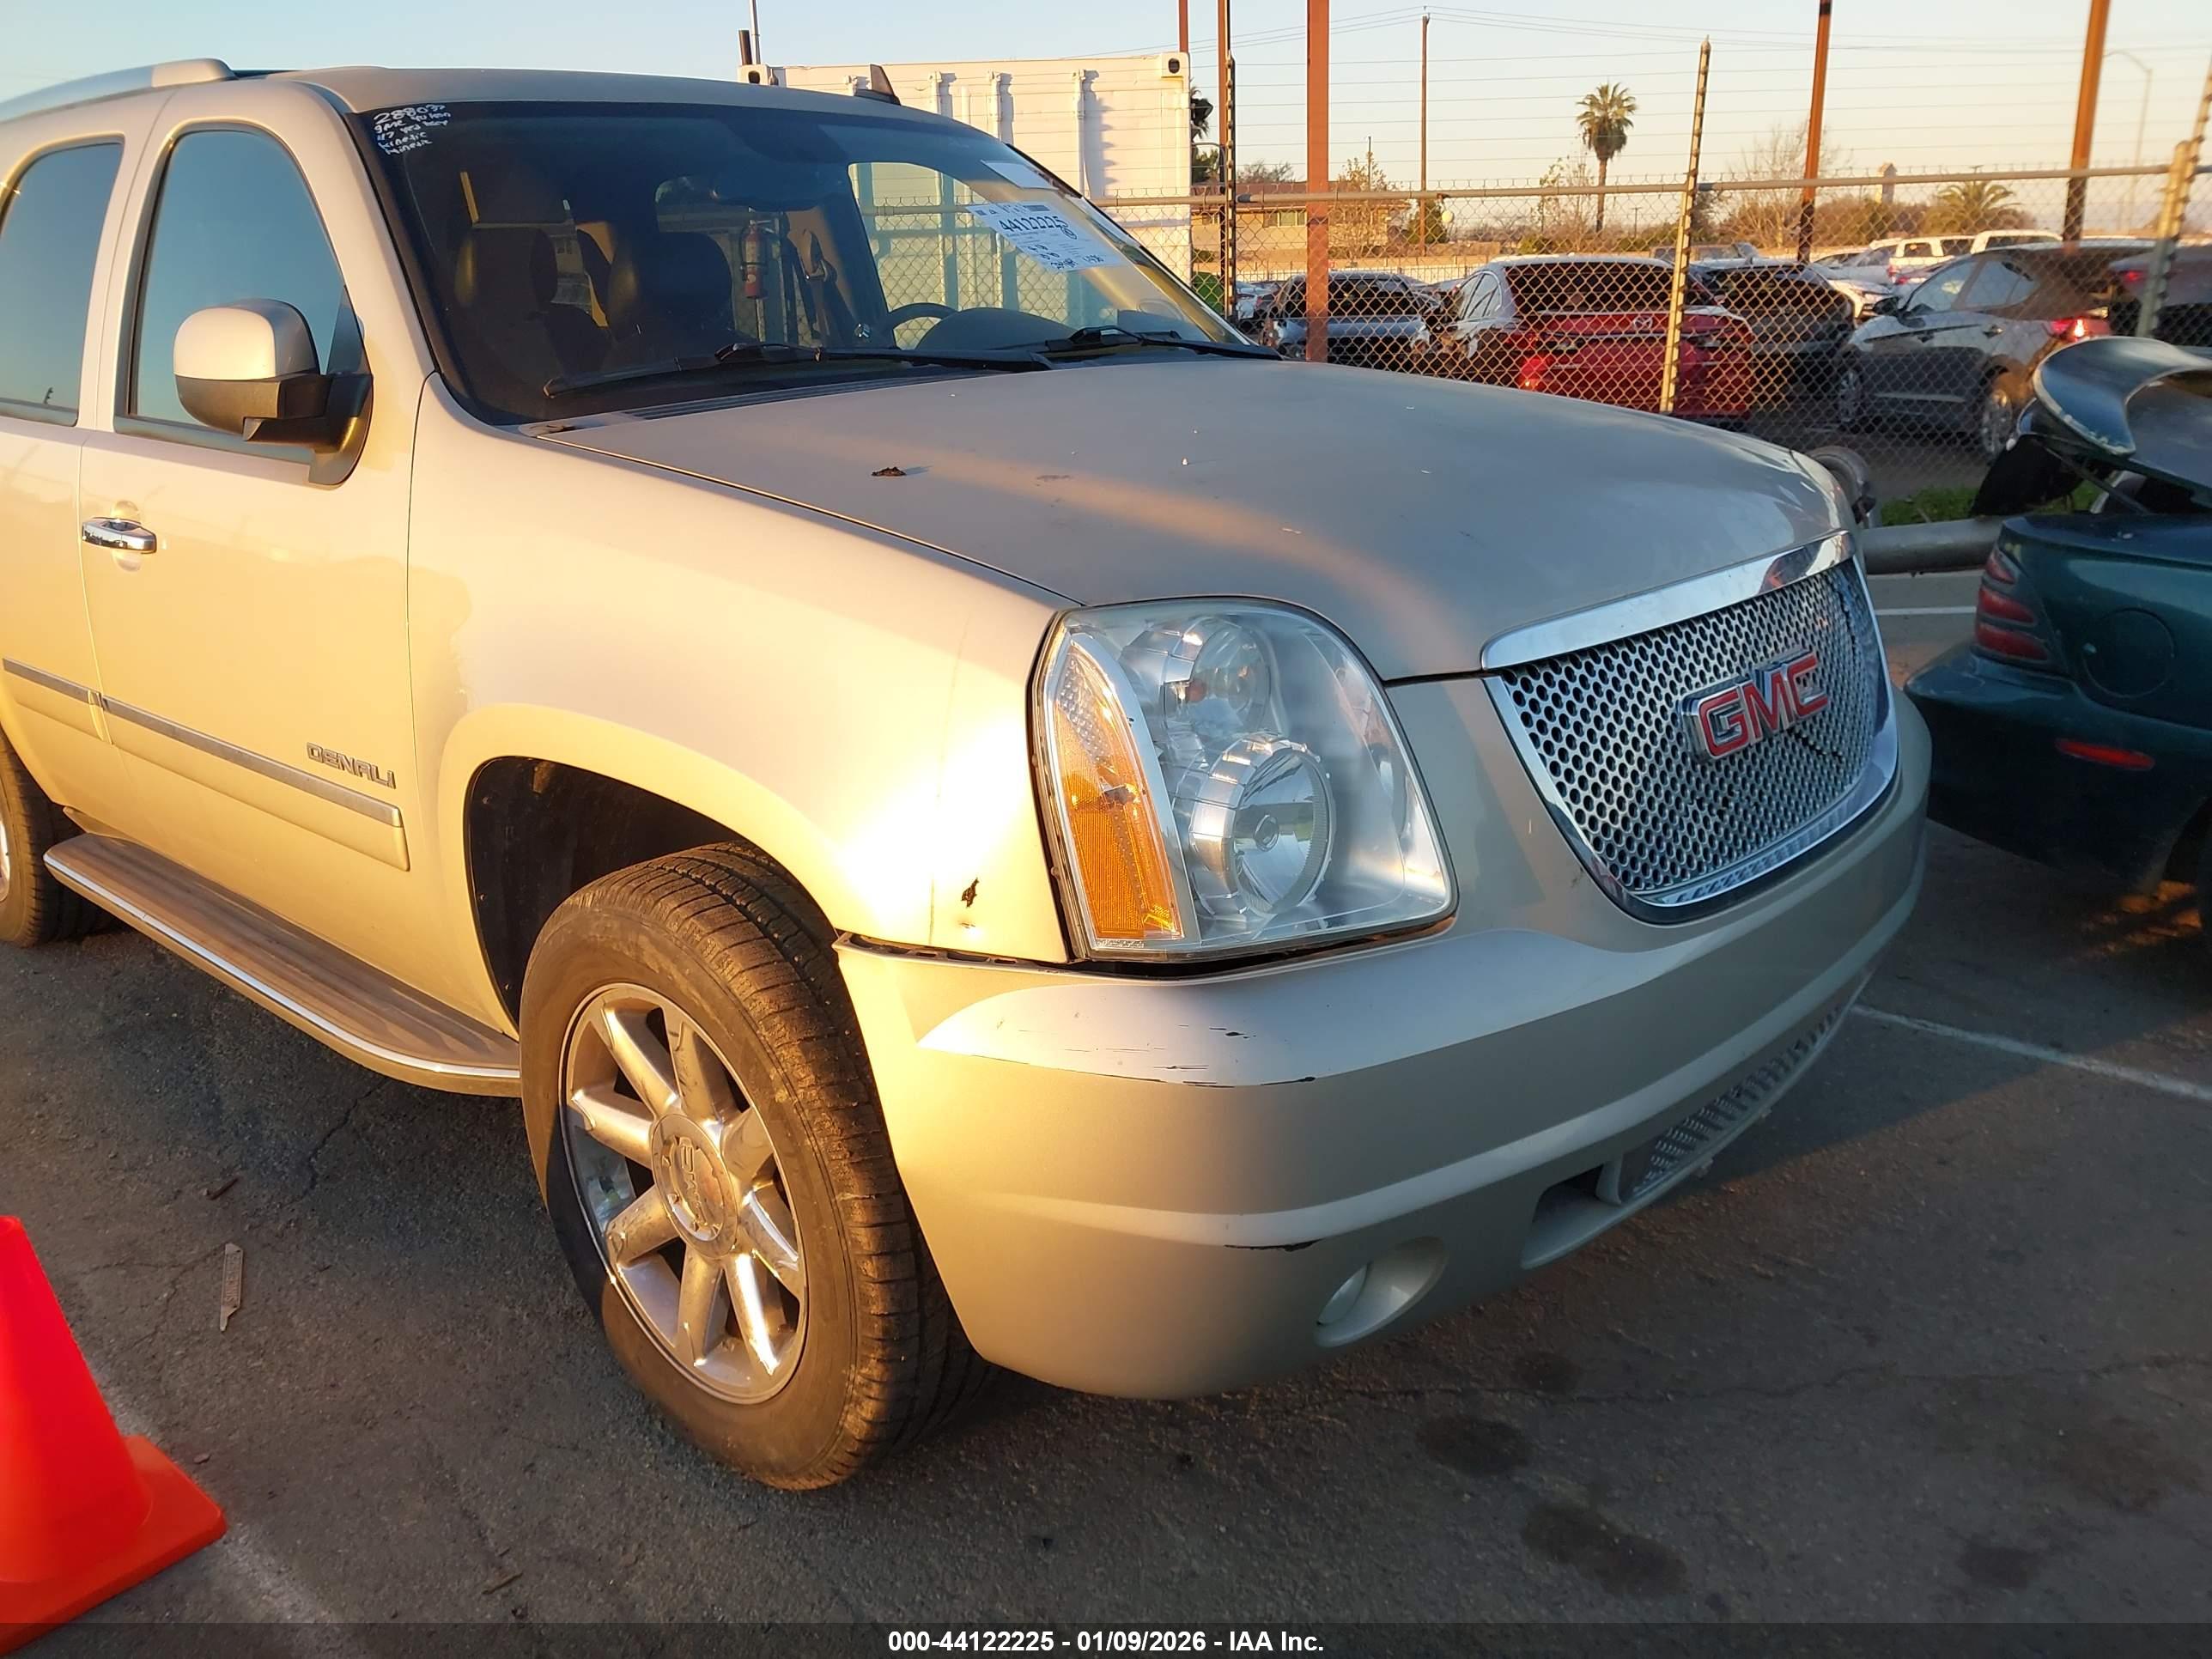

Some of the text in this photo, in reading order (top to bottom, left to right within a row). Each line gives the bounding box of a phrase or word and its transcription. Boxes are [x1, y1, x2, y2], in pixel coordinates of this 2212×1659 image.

[999, 216, 1068, 233] 44122225
[1697, 653, 1829, 760] GMC
[307, 741, 397, 790] DENALI
